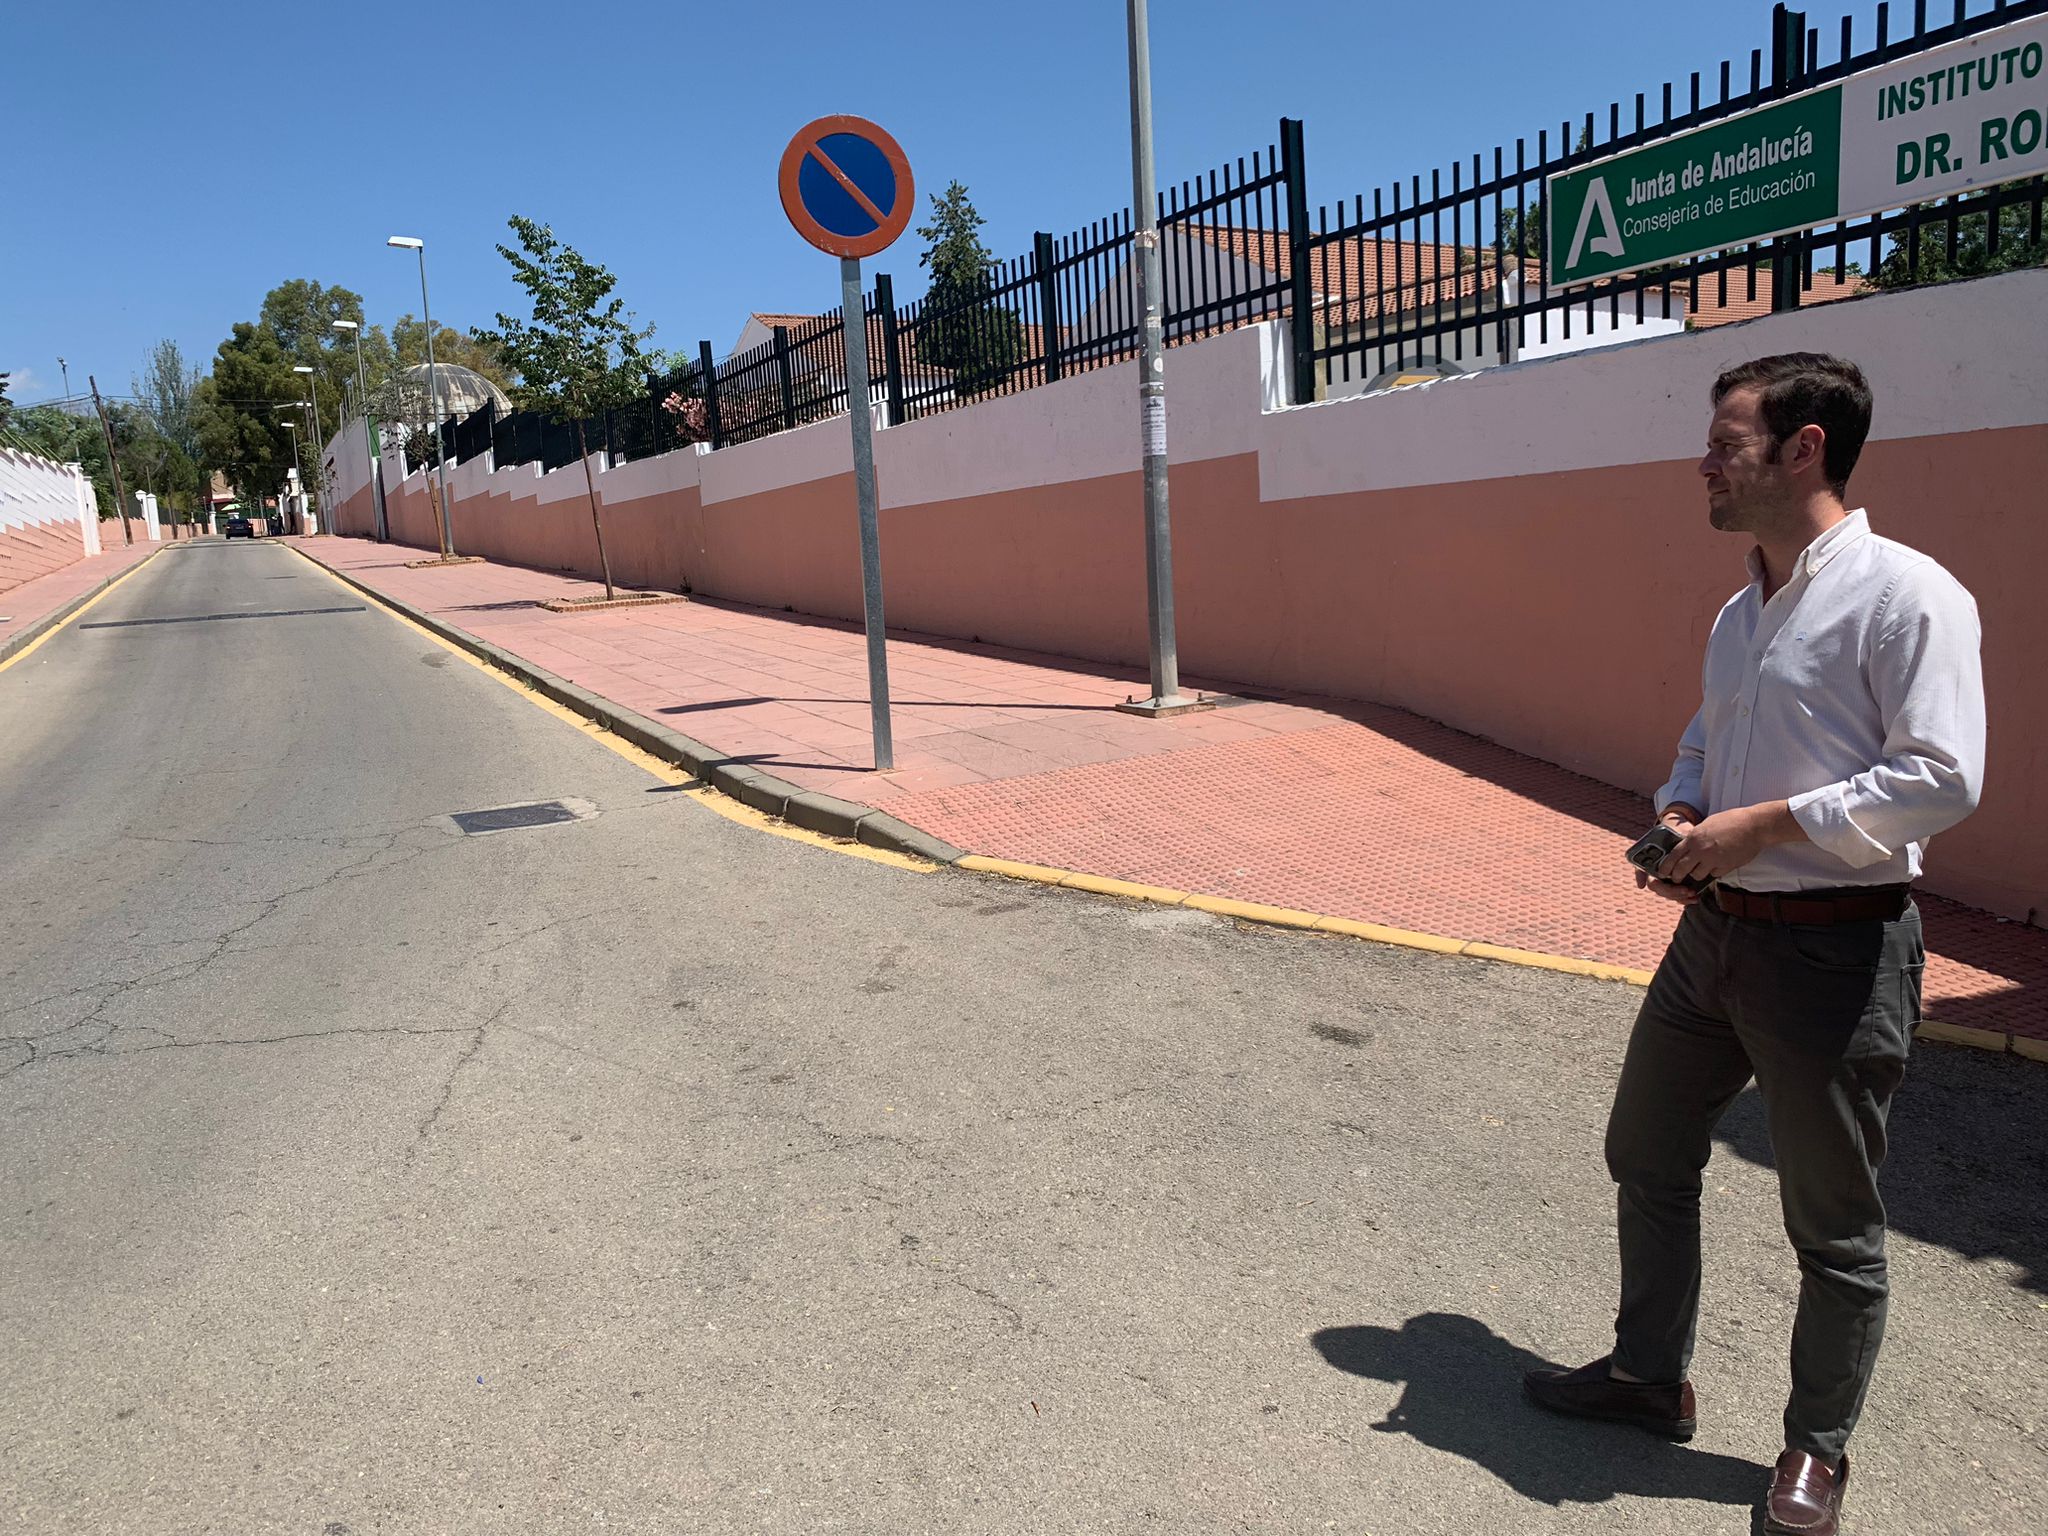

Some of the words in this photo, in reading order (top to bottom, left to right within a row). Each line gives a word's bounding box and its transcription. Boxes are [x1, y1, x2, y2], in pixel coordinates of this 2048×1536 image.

[1877, 41, 2043, 121] INSTITUTO
[1625, 169, 1676, 207] Junta
[1681, 160, 1704, 189] de
[1709, 125, 1813, 183] Andalucía
[1896, 132, 1963, 185] DR.
[1980, 106, 2048, 165] RO
[1623, 201, 1700, 238] Consejería
[1704, 194, 1724, 216] de
[1729, 169, 1816, 210] Educación
